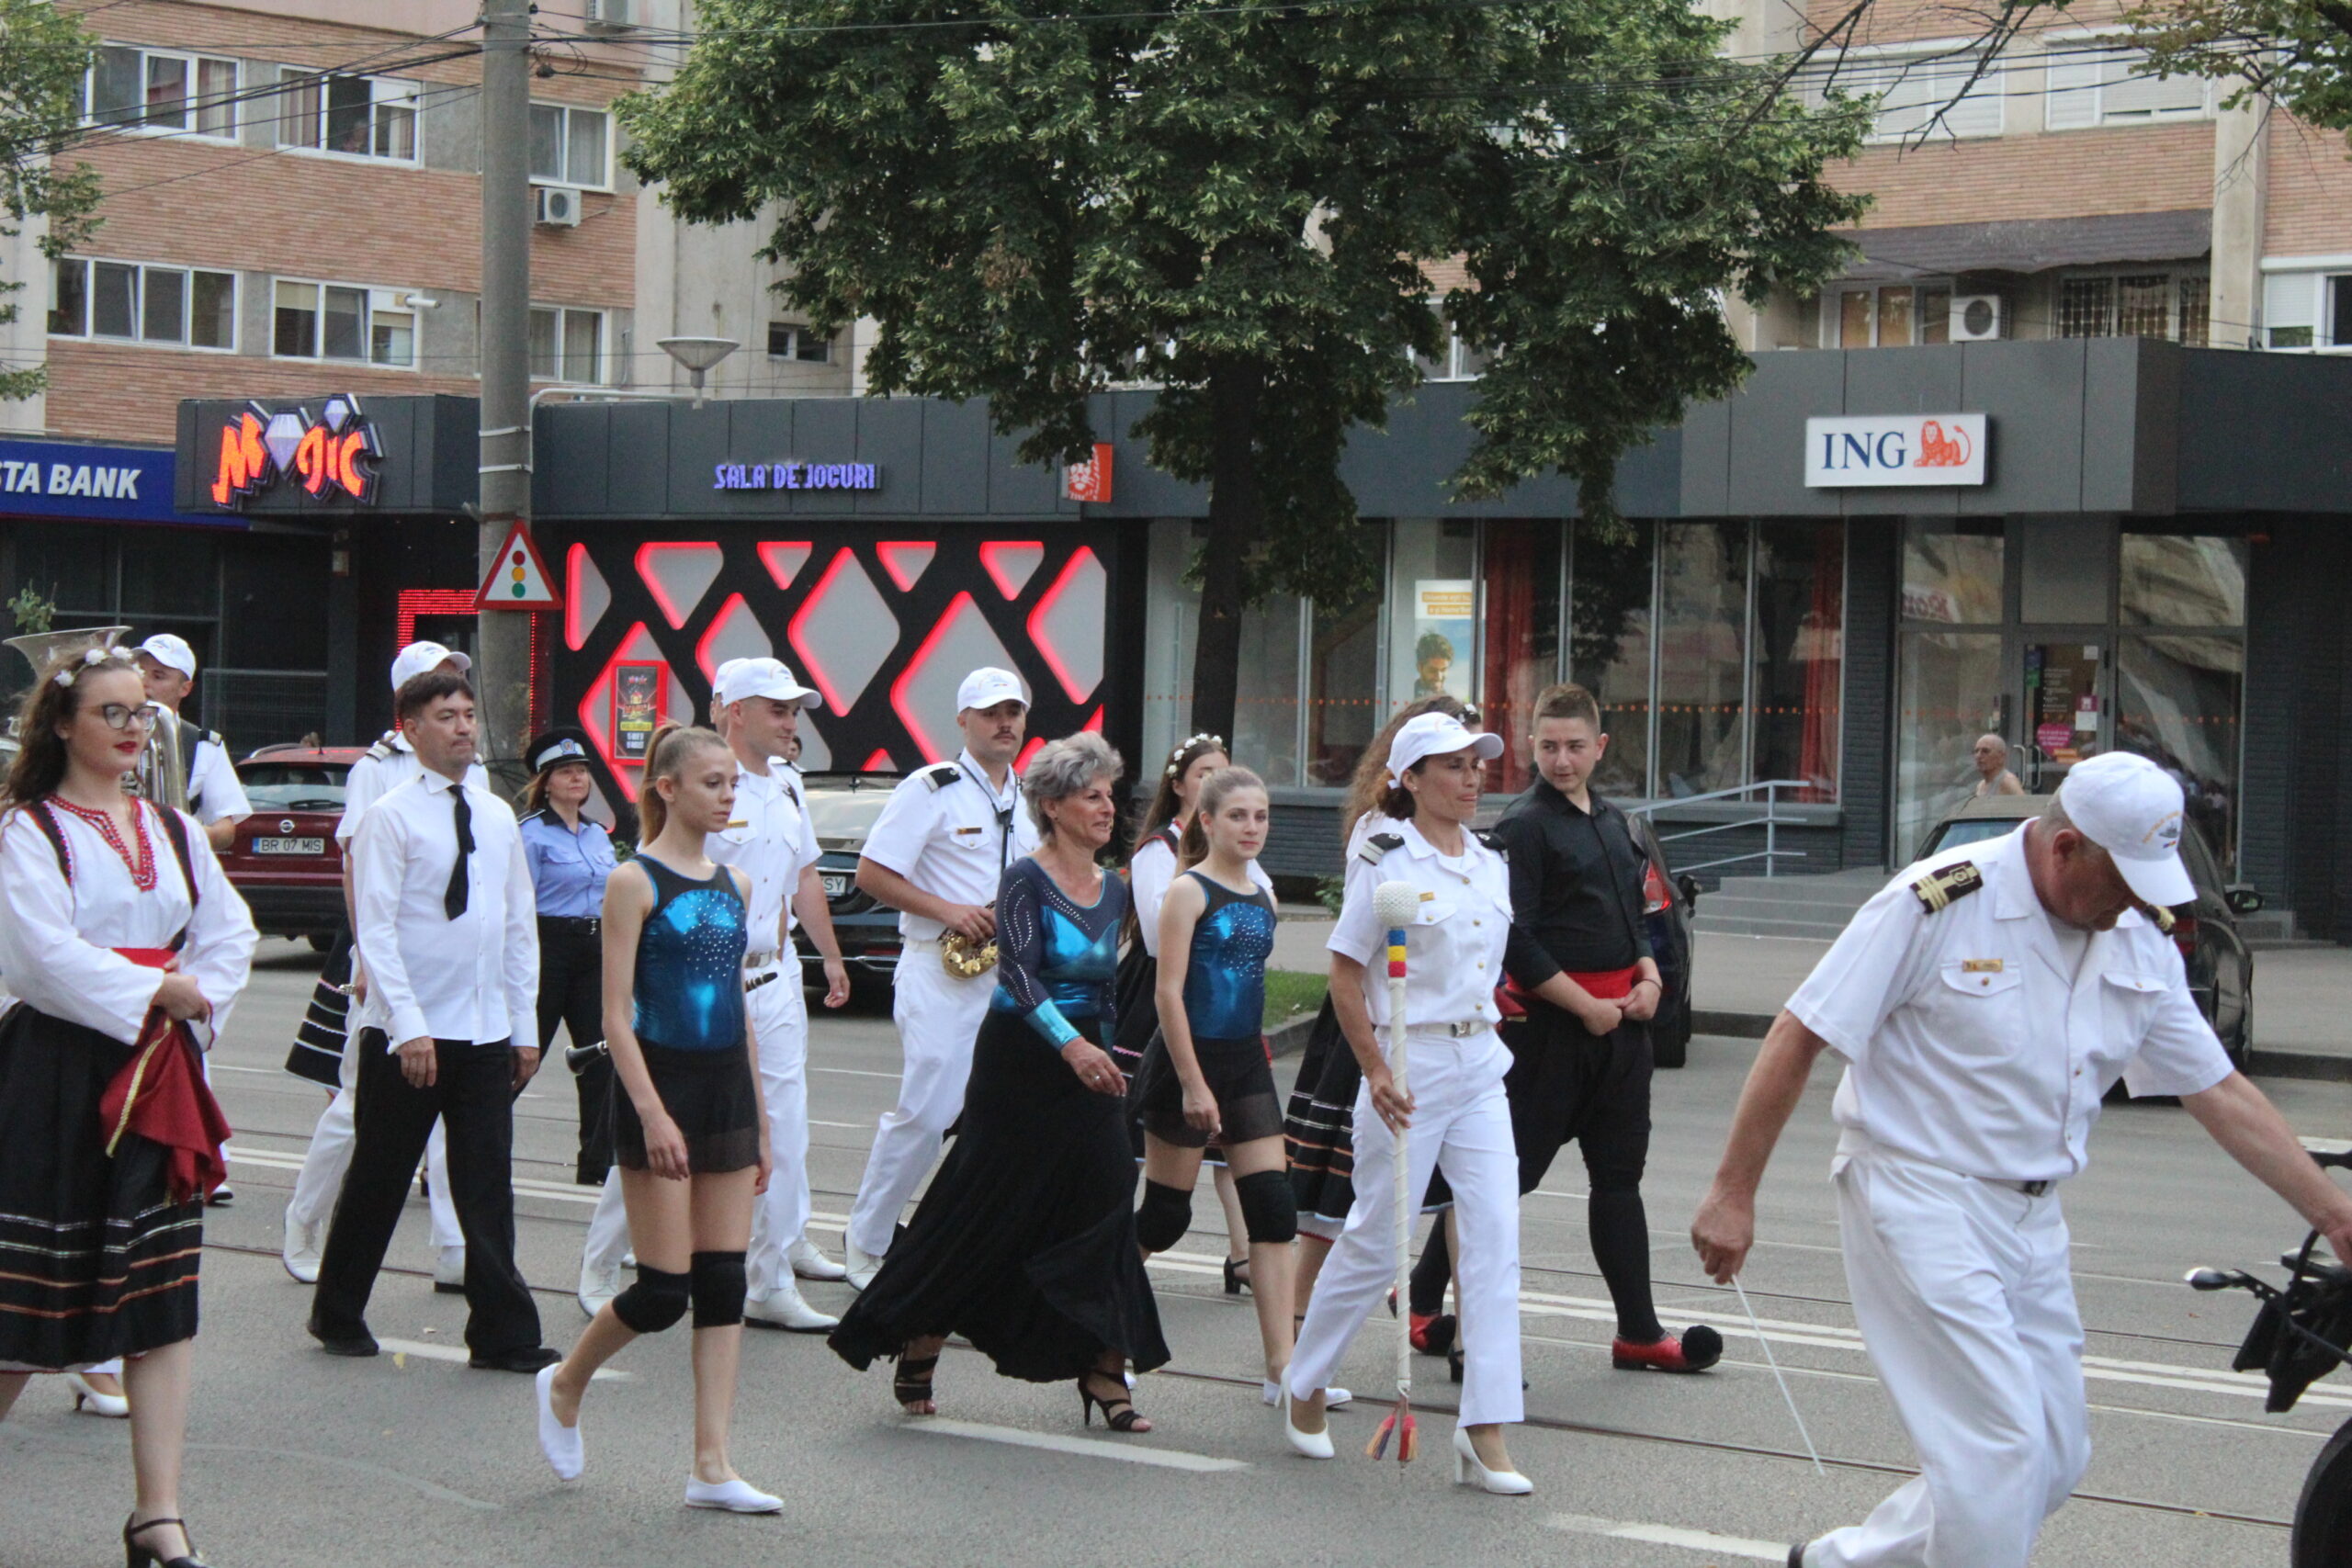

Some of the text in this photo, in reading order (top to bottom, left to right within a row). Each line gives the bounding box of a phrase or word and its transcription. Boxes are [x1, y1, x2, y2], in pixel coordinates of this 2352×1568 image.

[1822, 431, 1907, 469] ING
[0, 461, 141, 500] TA BANK
[714, 464, 876, 489] SALA DE JOCURI
[262, 840, 322, 852] BR 07 MIS
[821, 877, 843, 891] SY
